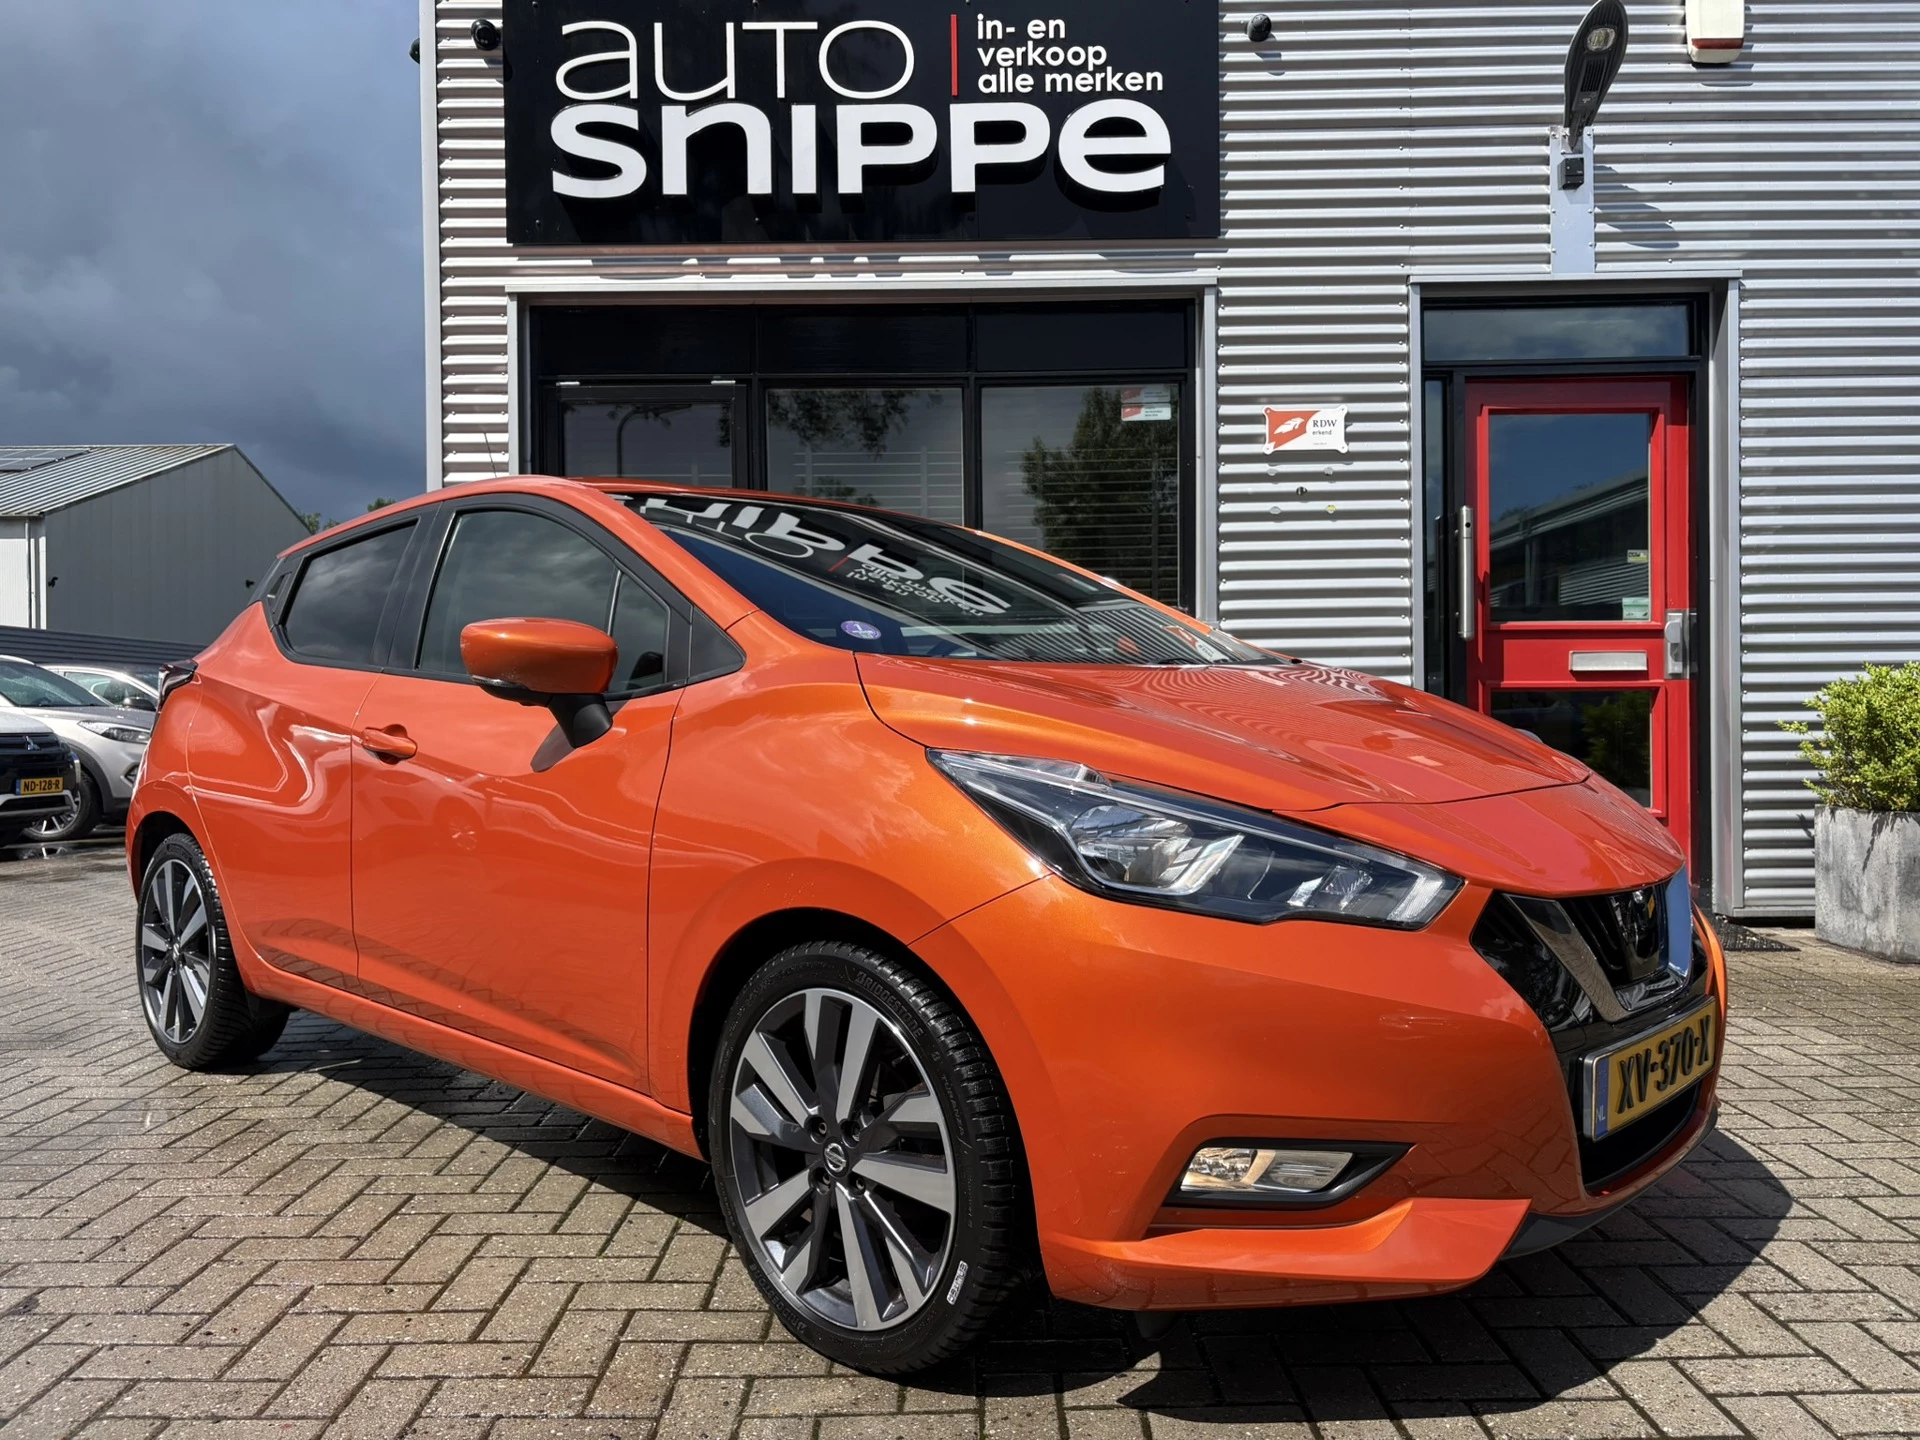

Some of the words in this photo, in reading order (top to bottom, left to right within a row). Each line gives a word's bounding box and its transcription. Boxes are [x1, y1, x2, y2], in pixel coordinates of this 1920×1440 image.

[976, 13, 1016, 40] in-
[1026, 18, 1066, 40] en
[976, 40, 1108, 72] verkoop
[977, 67, 1035, 94] alle
[1044, 65, 1164, 93] merken
[1312, 419, 1338, 428] RDW
[22, 779, 61, 792] ND-128-R
[1616, 1014, 1712, 1115] XV-370-X
[1595, 1106, 1606, 1123] NL
